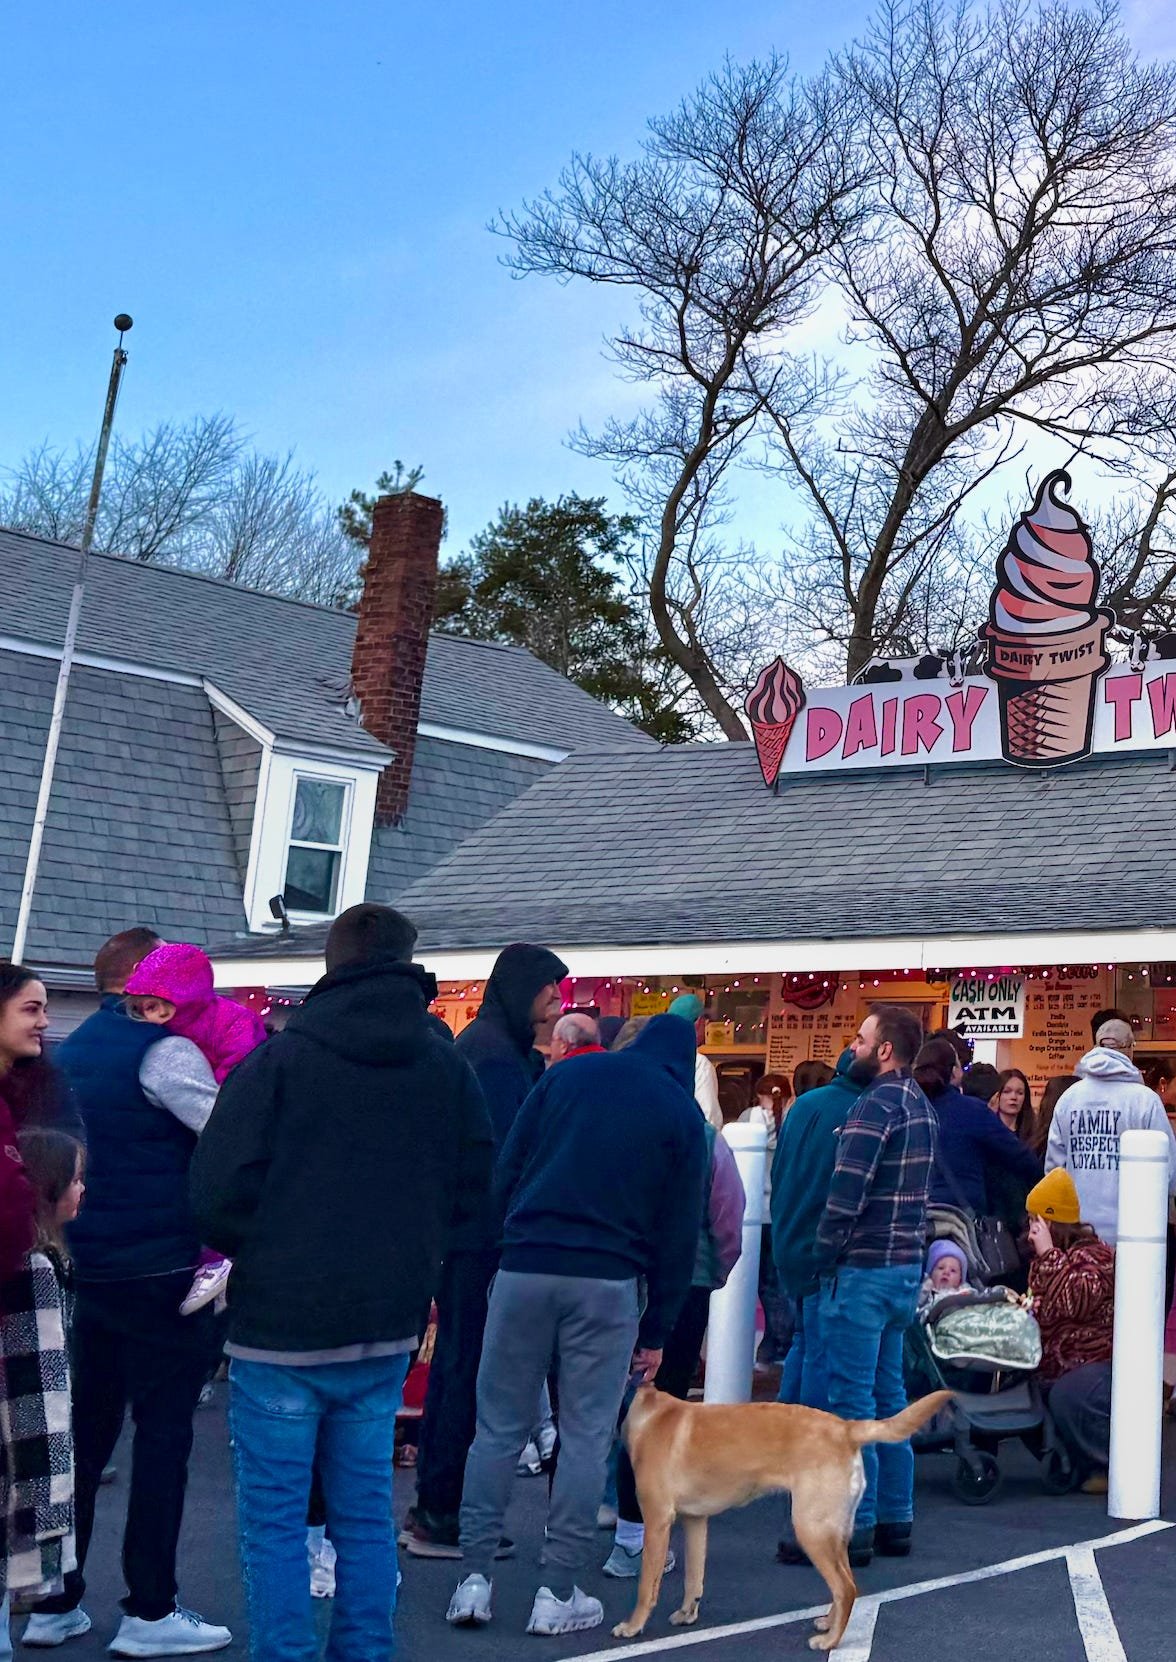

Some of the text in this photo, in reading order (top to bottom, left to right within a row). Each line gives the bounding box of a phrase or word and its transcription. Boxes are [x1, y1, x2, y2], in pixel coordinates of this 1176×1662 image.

[1000, 641, 1095, 666] DAIRY TWIST
[806, 685, 989, 763] DAIRY
[988, 977, 1020, 1003] ONLY
[955, 1007, 1016, 1020] ATM
[965, 1025, 1016, 1033] AVAILABLE
[1070, 1110, 1121, 1135] FAMILY
[1070, 1136, 1120, 1153] RESPECT
[1071, 1153, 1120, 1171] LOYALTY
